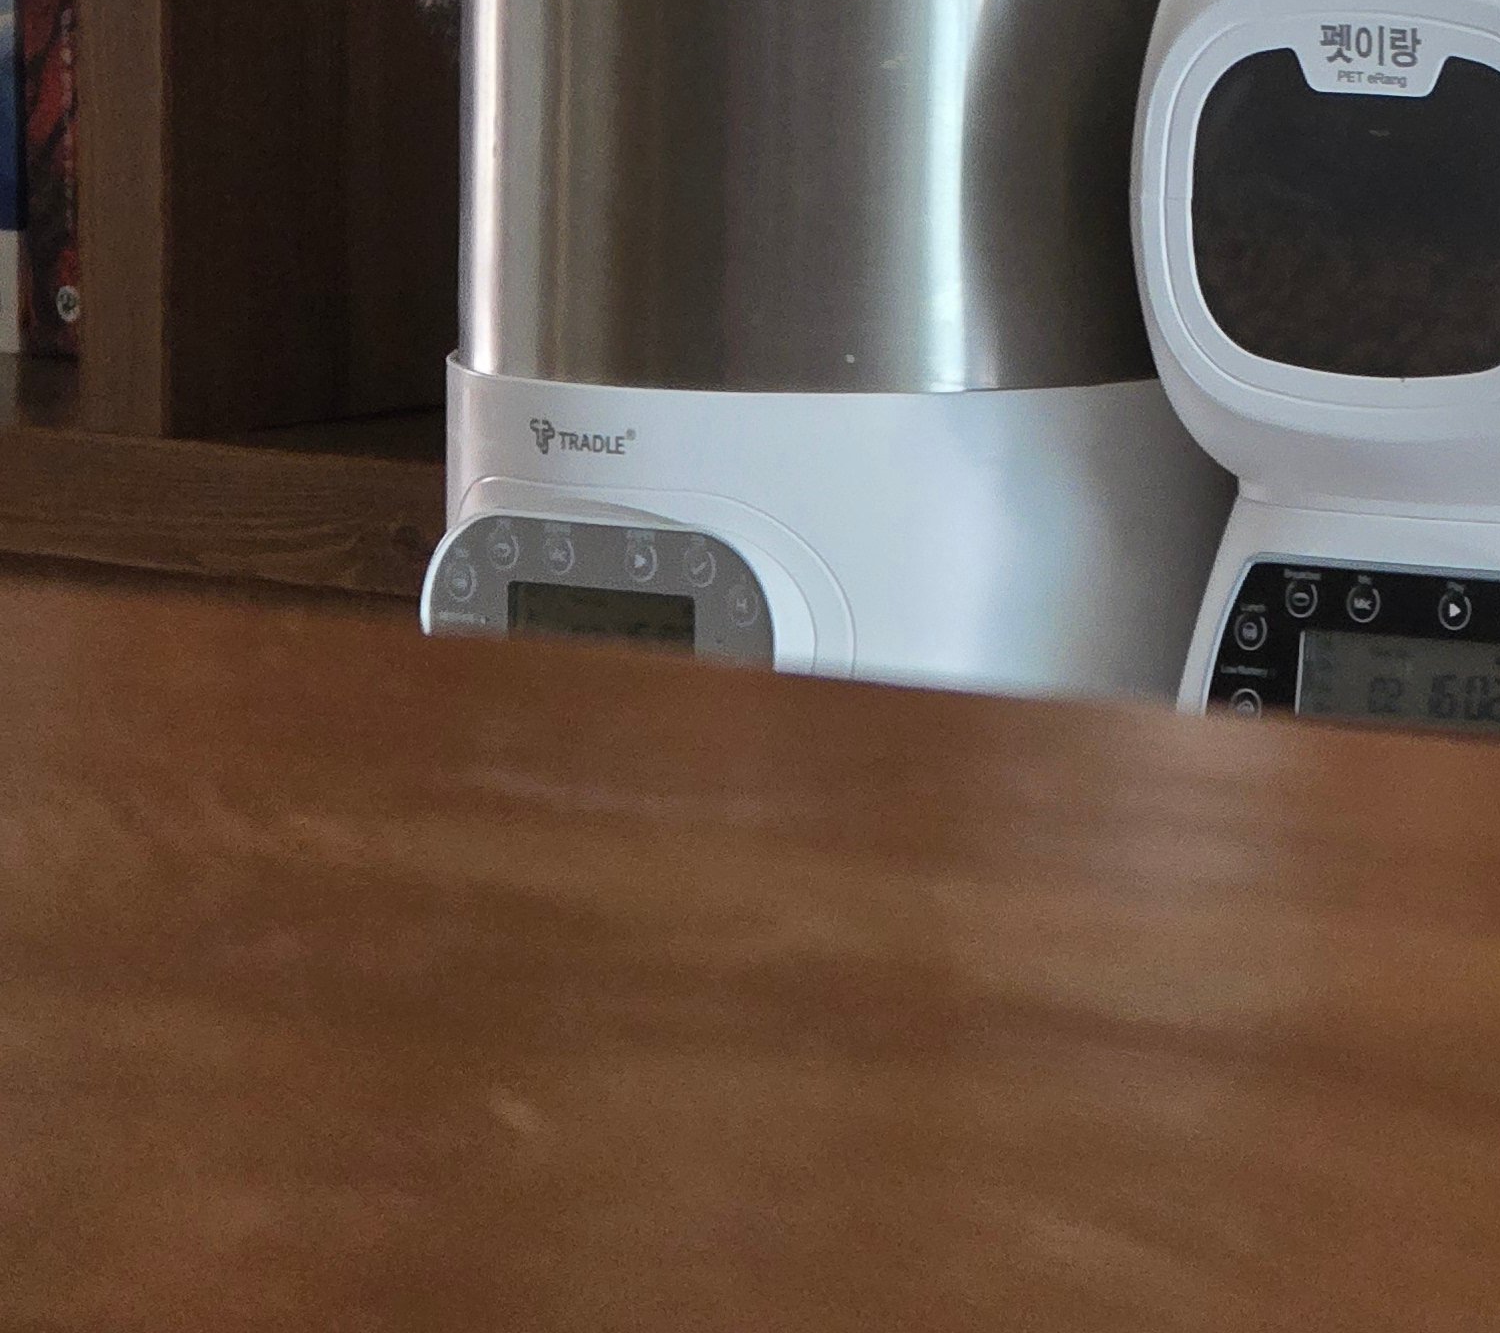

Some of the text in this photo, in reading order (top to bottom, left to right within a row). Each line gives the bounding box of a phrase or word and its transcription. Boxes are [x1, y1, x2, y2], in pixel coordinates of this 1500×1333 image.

[1320, 23, 1422, 70] 펫이랑
[1337, 70, 1364, 83] PET
[559, 430, 626, 455] TRADLE
